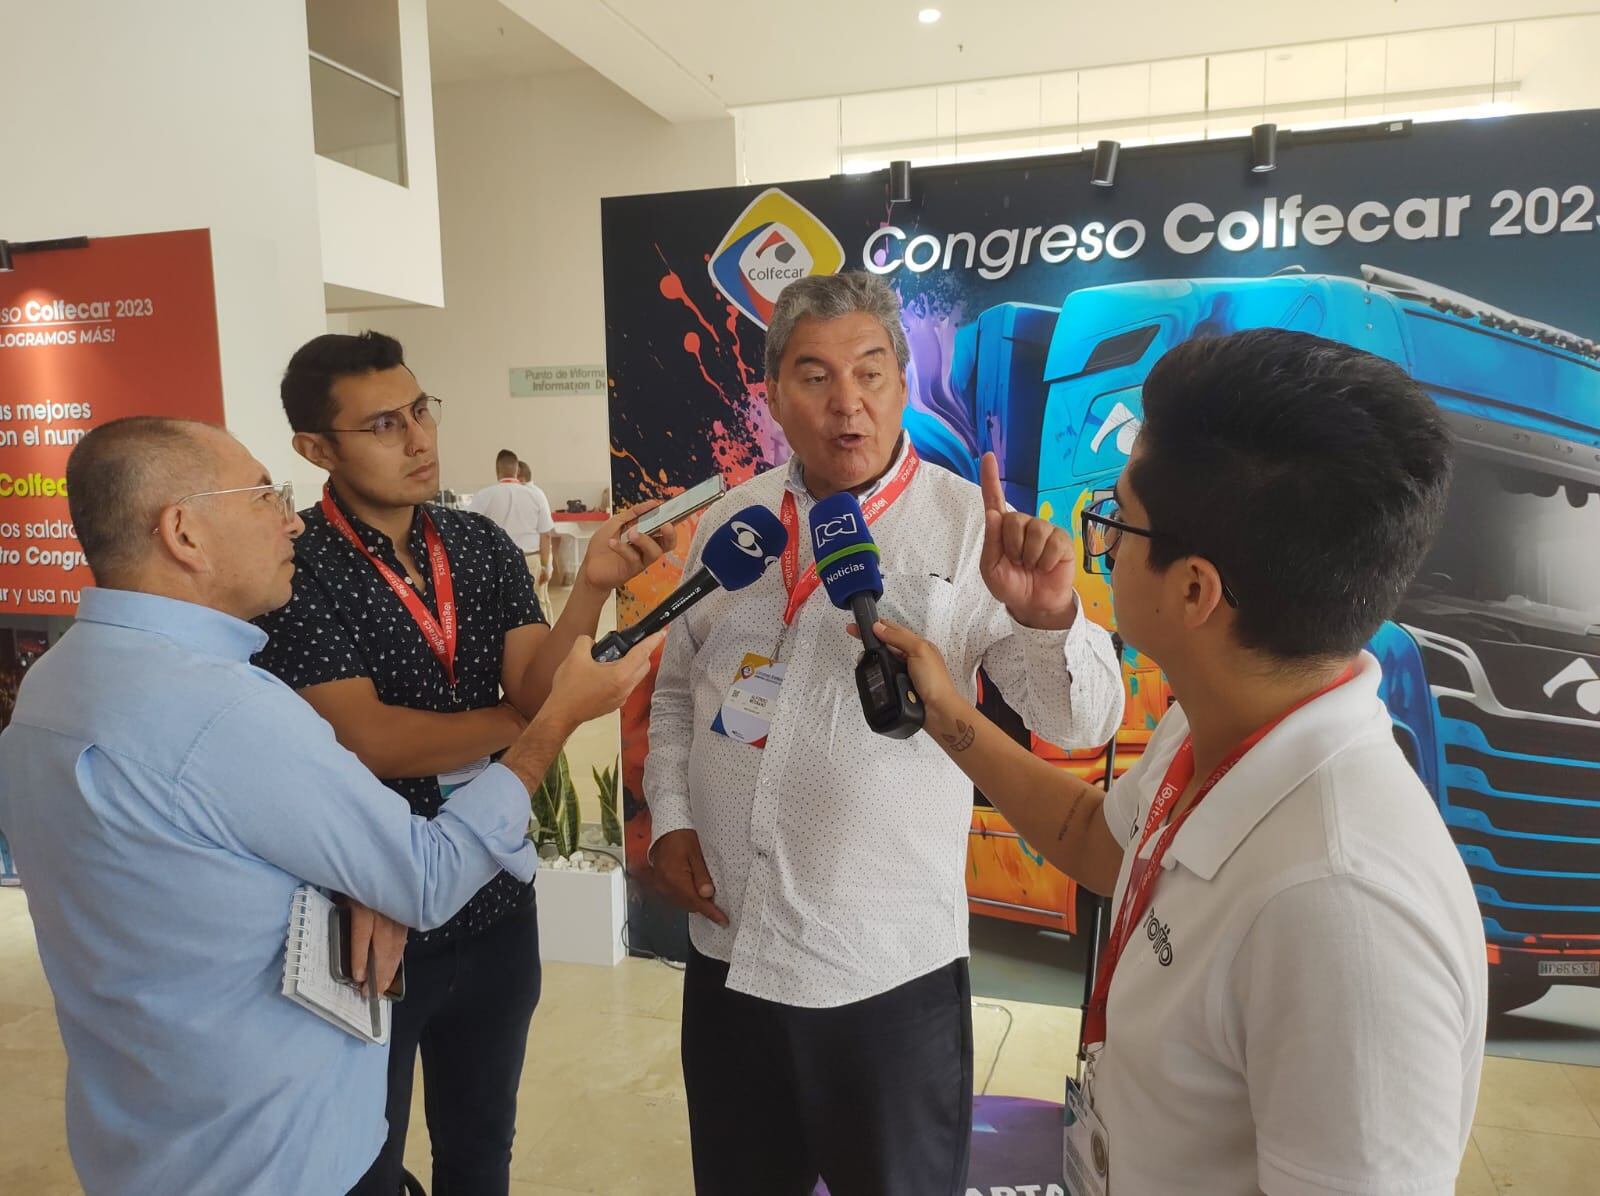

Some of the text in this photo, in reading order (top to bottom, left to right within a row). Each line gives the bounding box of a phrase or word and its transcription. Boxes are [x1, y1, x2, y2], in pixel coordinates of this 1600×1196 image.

[862, 184, 1600, 281] Congreso Colfecar 202
[748, 266, 805, 281] Colfecar
[25, 299, 110, 322] Colfecar
[115, 298, 153, 318] 2023
[80, 325, 116, 344] MÁS!
[556, 369, 567, 378] de
[532, 379, 590, 392] Information
[16, 399, 92, 424] mejores
[22, 425, 40, 447] el
[44, 427, 92, 446] num
[826, 562, 866, 585] Noticias
[12, 588, 22, 606] y
[27, 588, 56, 604] usa
